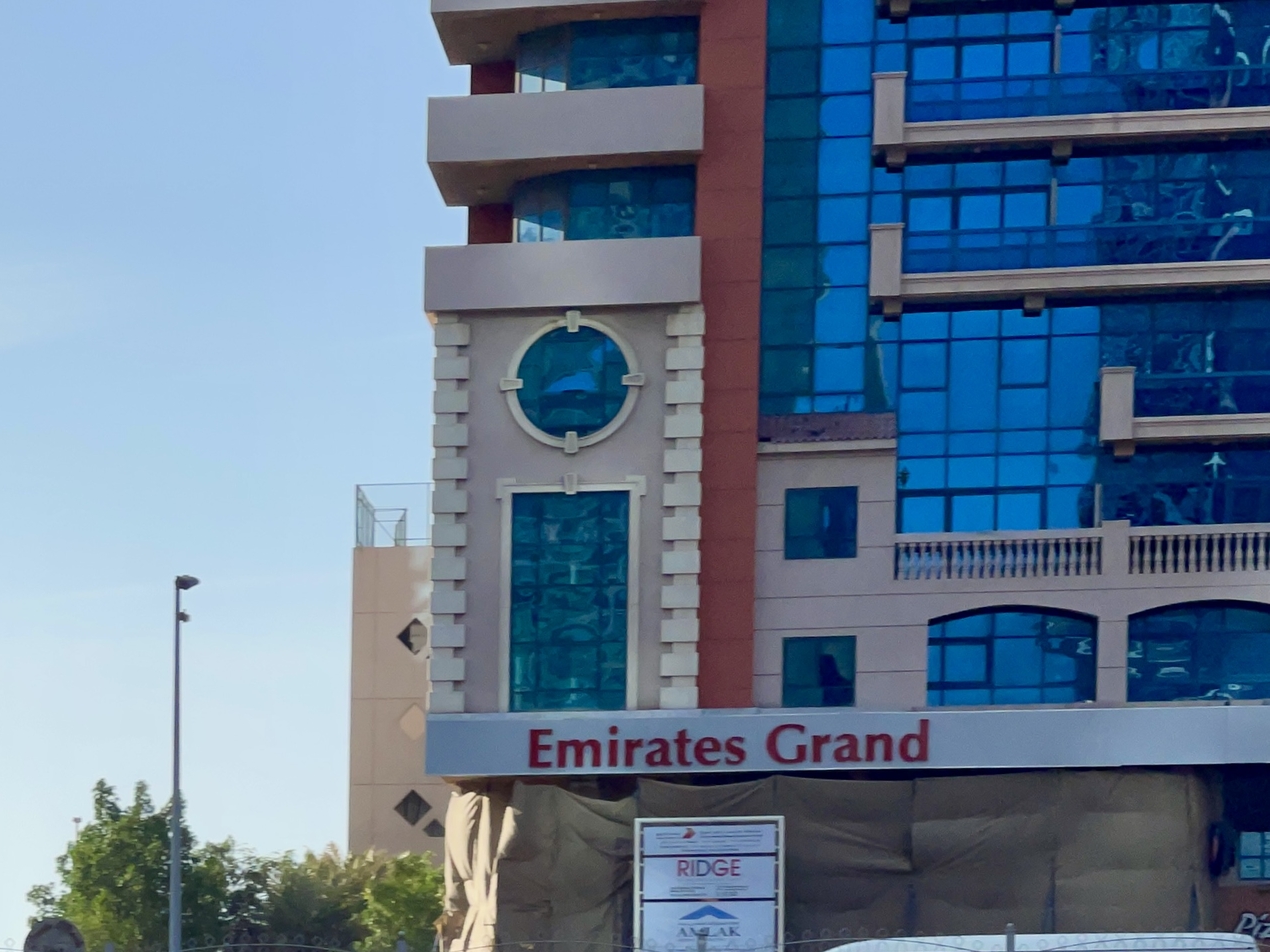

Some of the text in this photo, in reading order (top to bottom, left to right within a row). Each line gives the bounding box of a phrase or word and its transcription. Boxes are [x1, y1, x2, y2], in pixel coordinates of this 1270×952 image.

[528, 719, 930, 768] Emirates Grand
[677, 859, 742, 877] RIDGE
